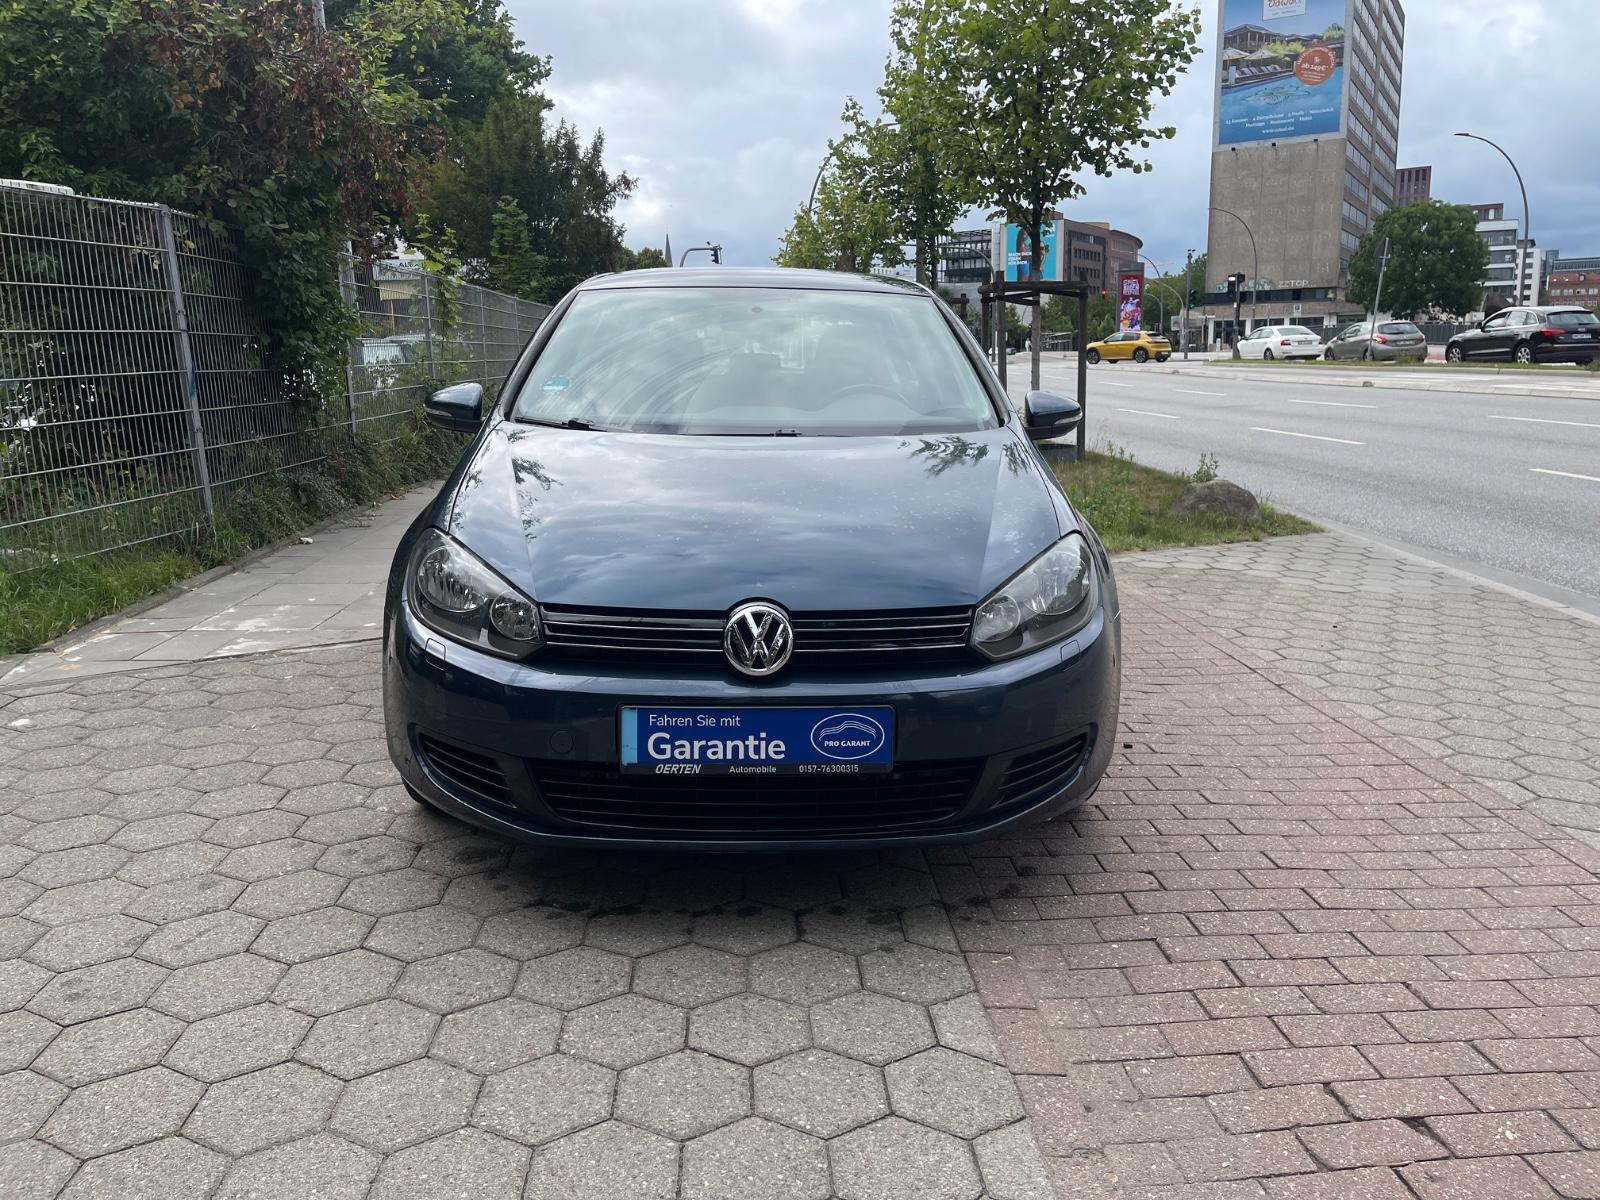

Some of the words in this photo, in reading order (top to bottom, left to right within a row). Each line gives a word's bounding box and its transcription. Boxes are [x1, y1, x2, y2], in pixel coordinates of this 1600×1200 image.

[649, 714, 693, 727] Fahren
[696, 714, 716, 727] Sie
[720, 714, 741, 727] mit
[647, 732, 786, 760] Garantie
[655, 763, 702, 774] OERTEN
[729, 765, 777, 773] Automobile
[799, 764, 859, 773] 0157-76300315
